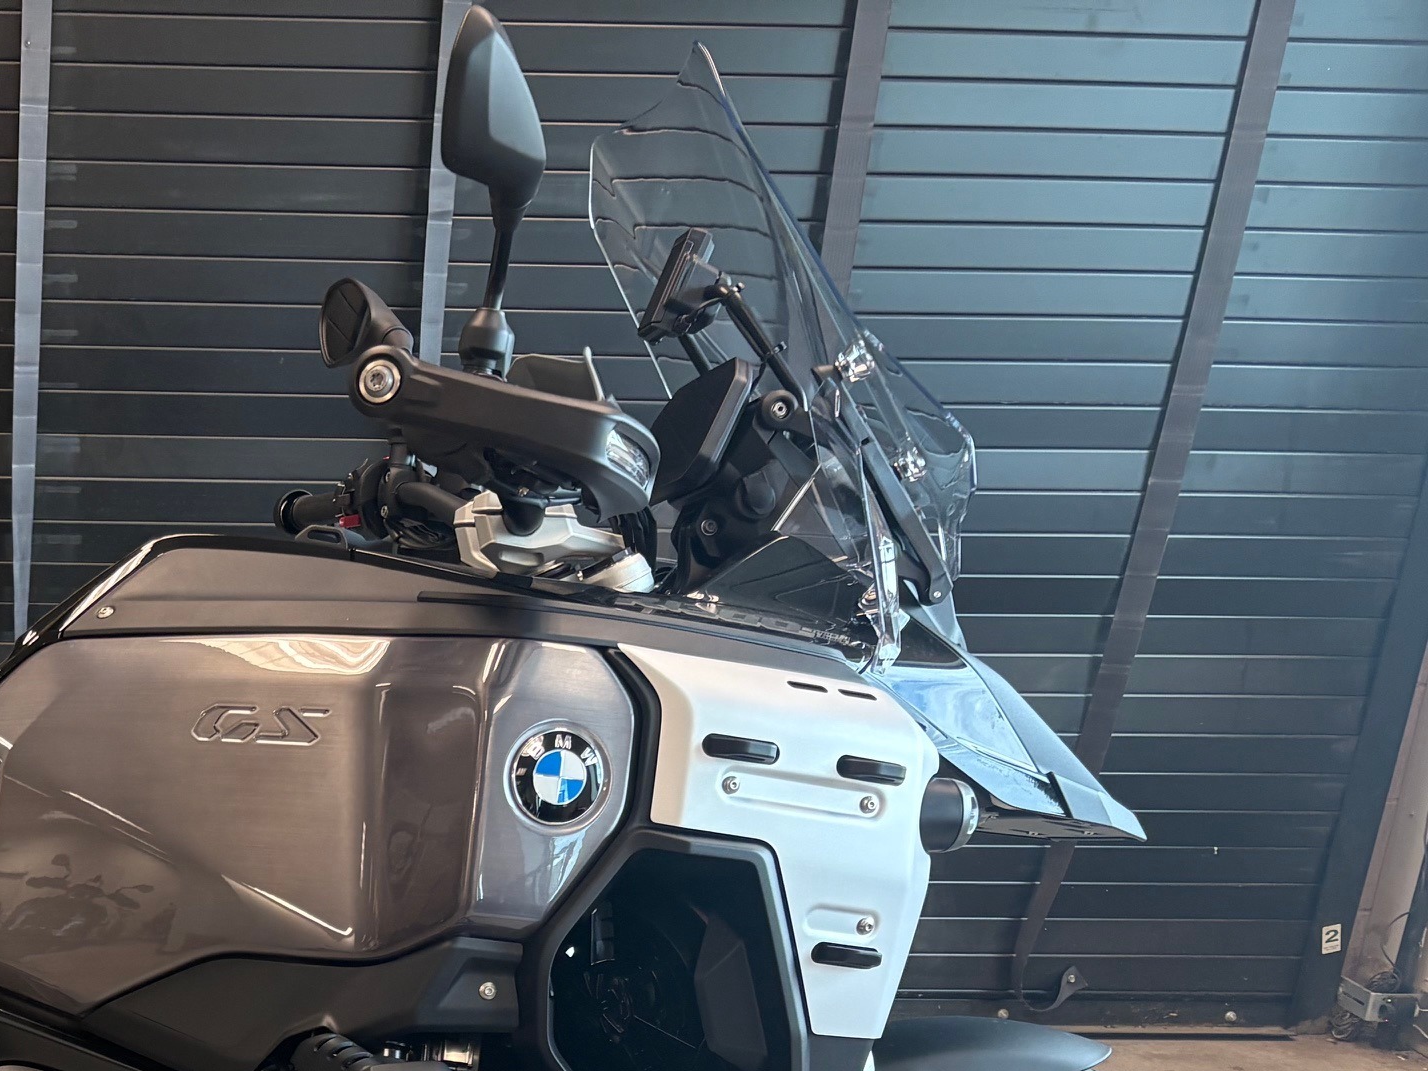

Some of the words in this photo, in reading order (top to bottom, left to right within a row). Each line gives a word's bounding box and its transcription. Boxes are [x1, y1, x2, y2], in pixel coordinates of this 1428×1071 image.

[191, 703, 332, 746] GS
[526, 733, 598, 767] BMW
[1324, 929, 1339, 943] 2
